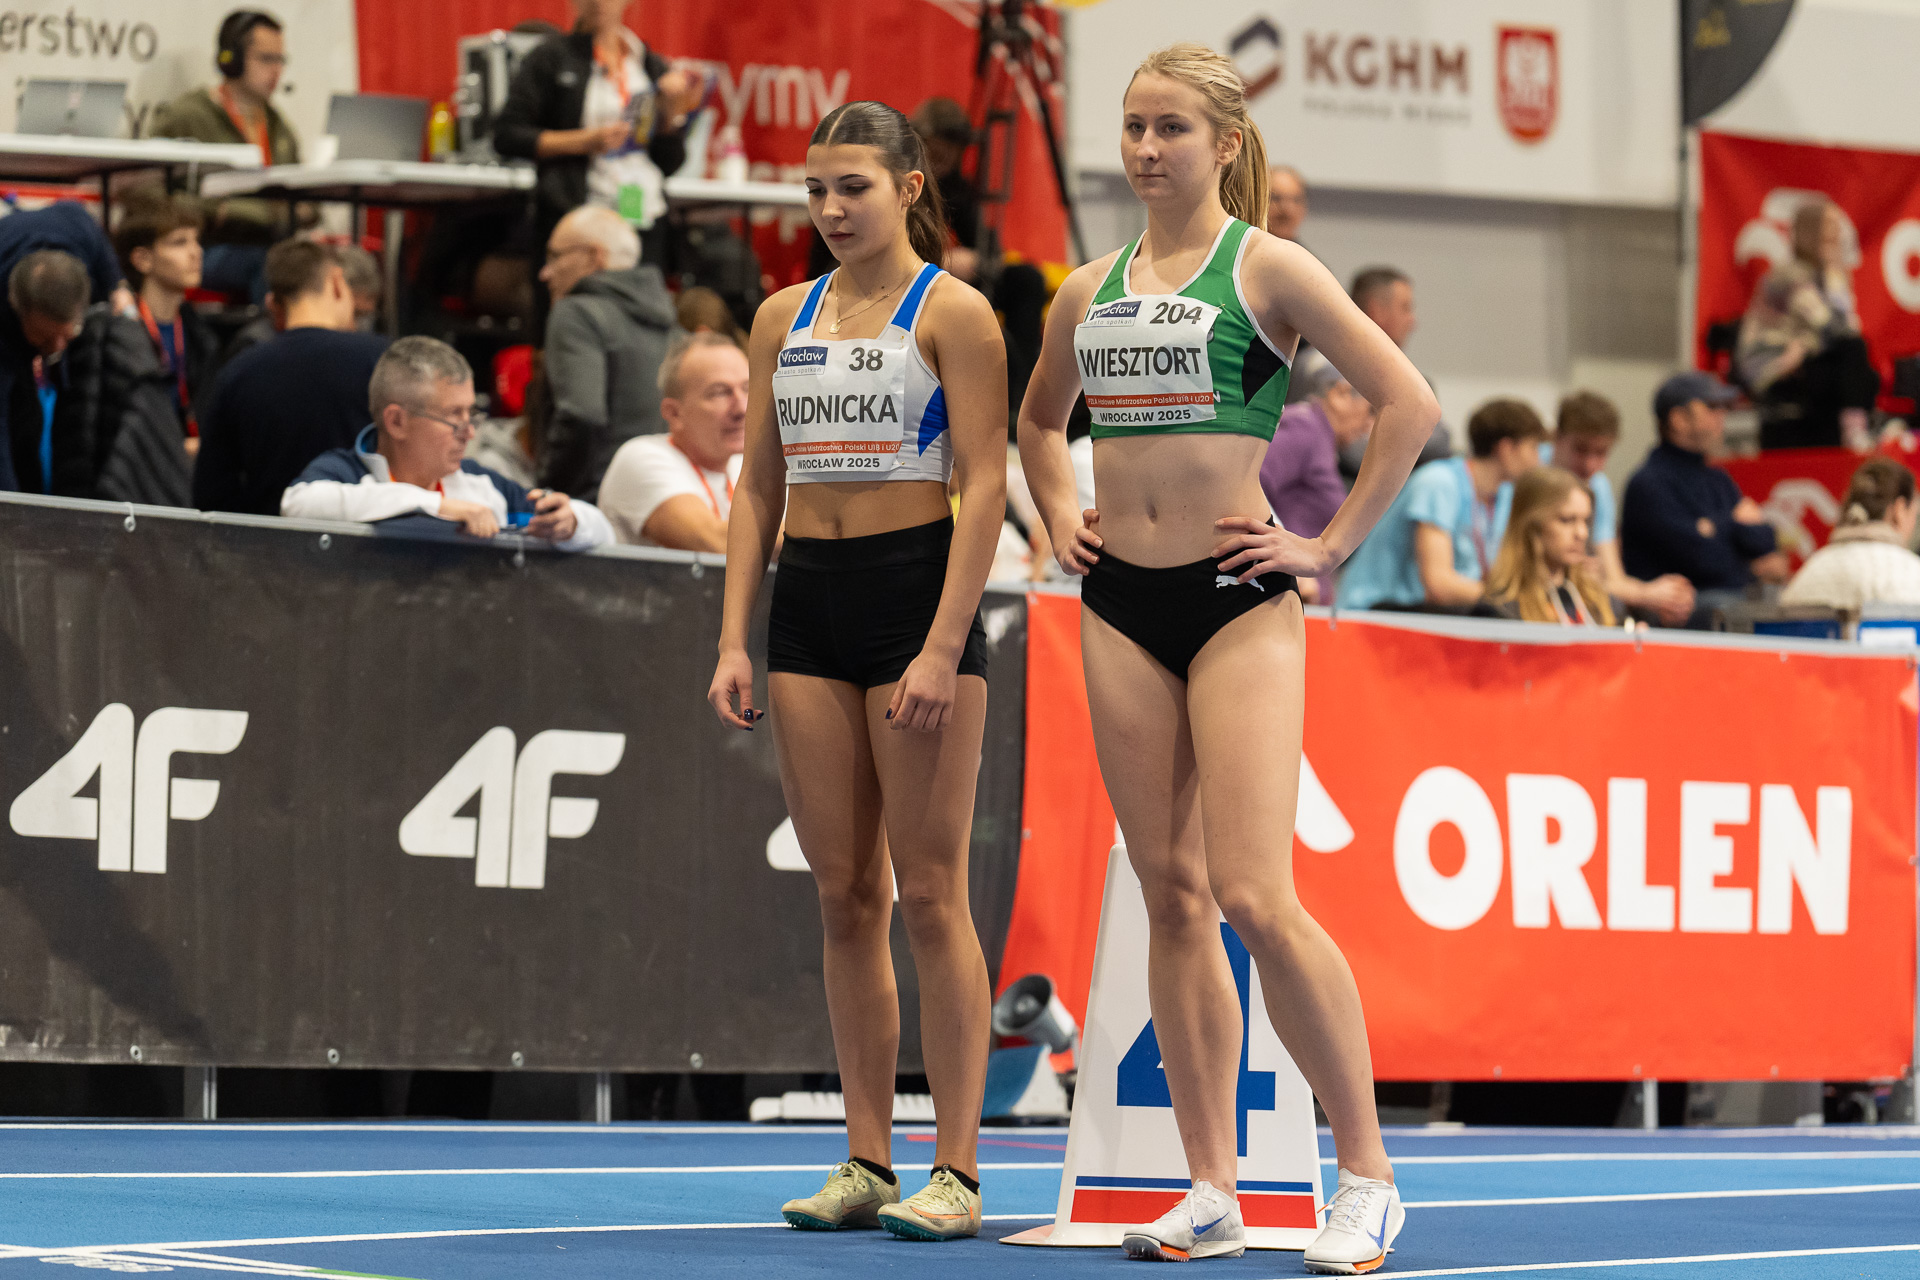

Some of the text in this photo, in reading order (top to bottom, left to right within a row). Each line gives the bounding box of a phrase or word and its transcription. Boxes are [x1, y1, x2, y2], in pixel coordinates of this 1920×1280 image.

[1304, 33, 1469, 93] KGHM
[1150, 302, 1203, 325] 204
[781, 347, 884, 371] Wrocław 38
[1079, 346, 1202, 378] WIESZTORT
[778, 394, 898, 427] RUDNICKA
[1116, 396, 1152, 405] Mistrzostwa
[1153, 394, 1175, 404] Polski
[1100, 409, 1191, 423] WROCŁAW 2025
[807, 443, 843, 452] Mistrzostwa
[844, 442, 867, 451] Polski
[886, 442, 900, 451] U20
[797, 457, 880, 470] WROCŁAW 2025
[10, 703, 249, 873] 4F
[400, 726, 626, 889] 4F
[1393, 766, 1852, 935] ORLEN
